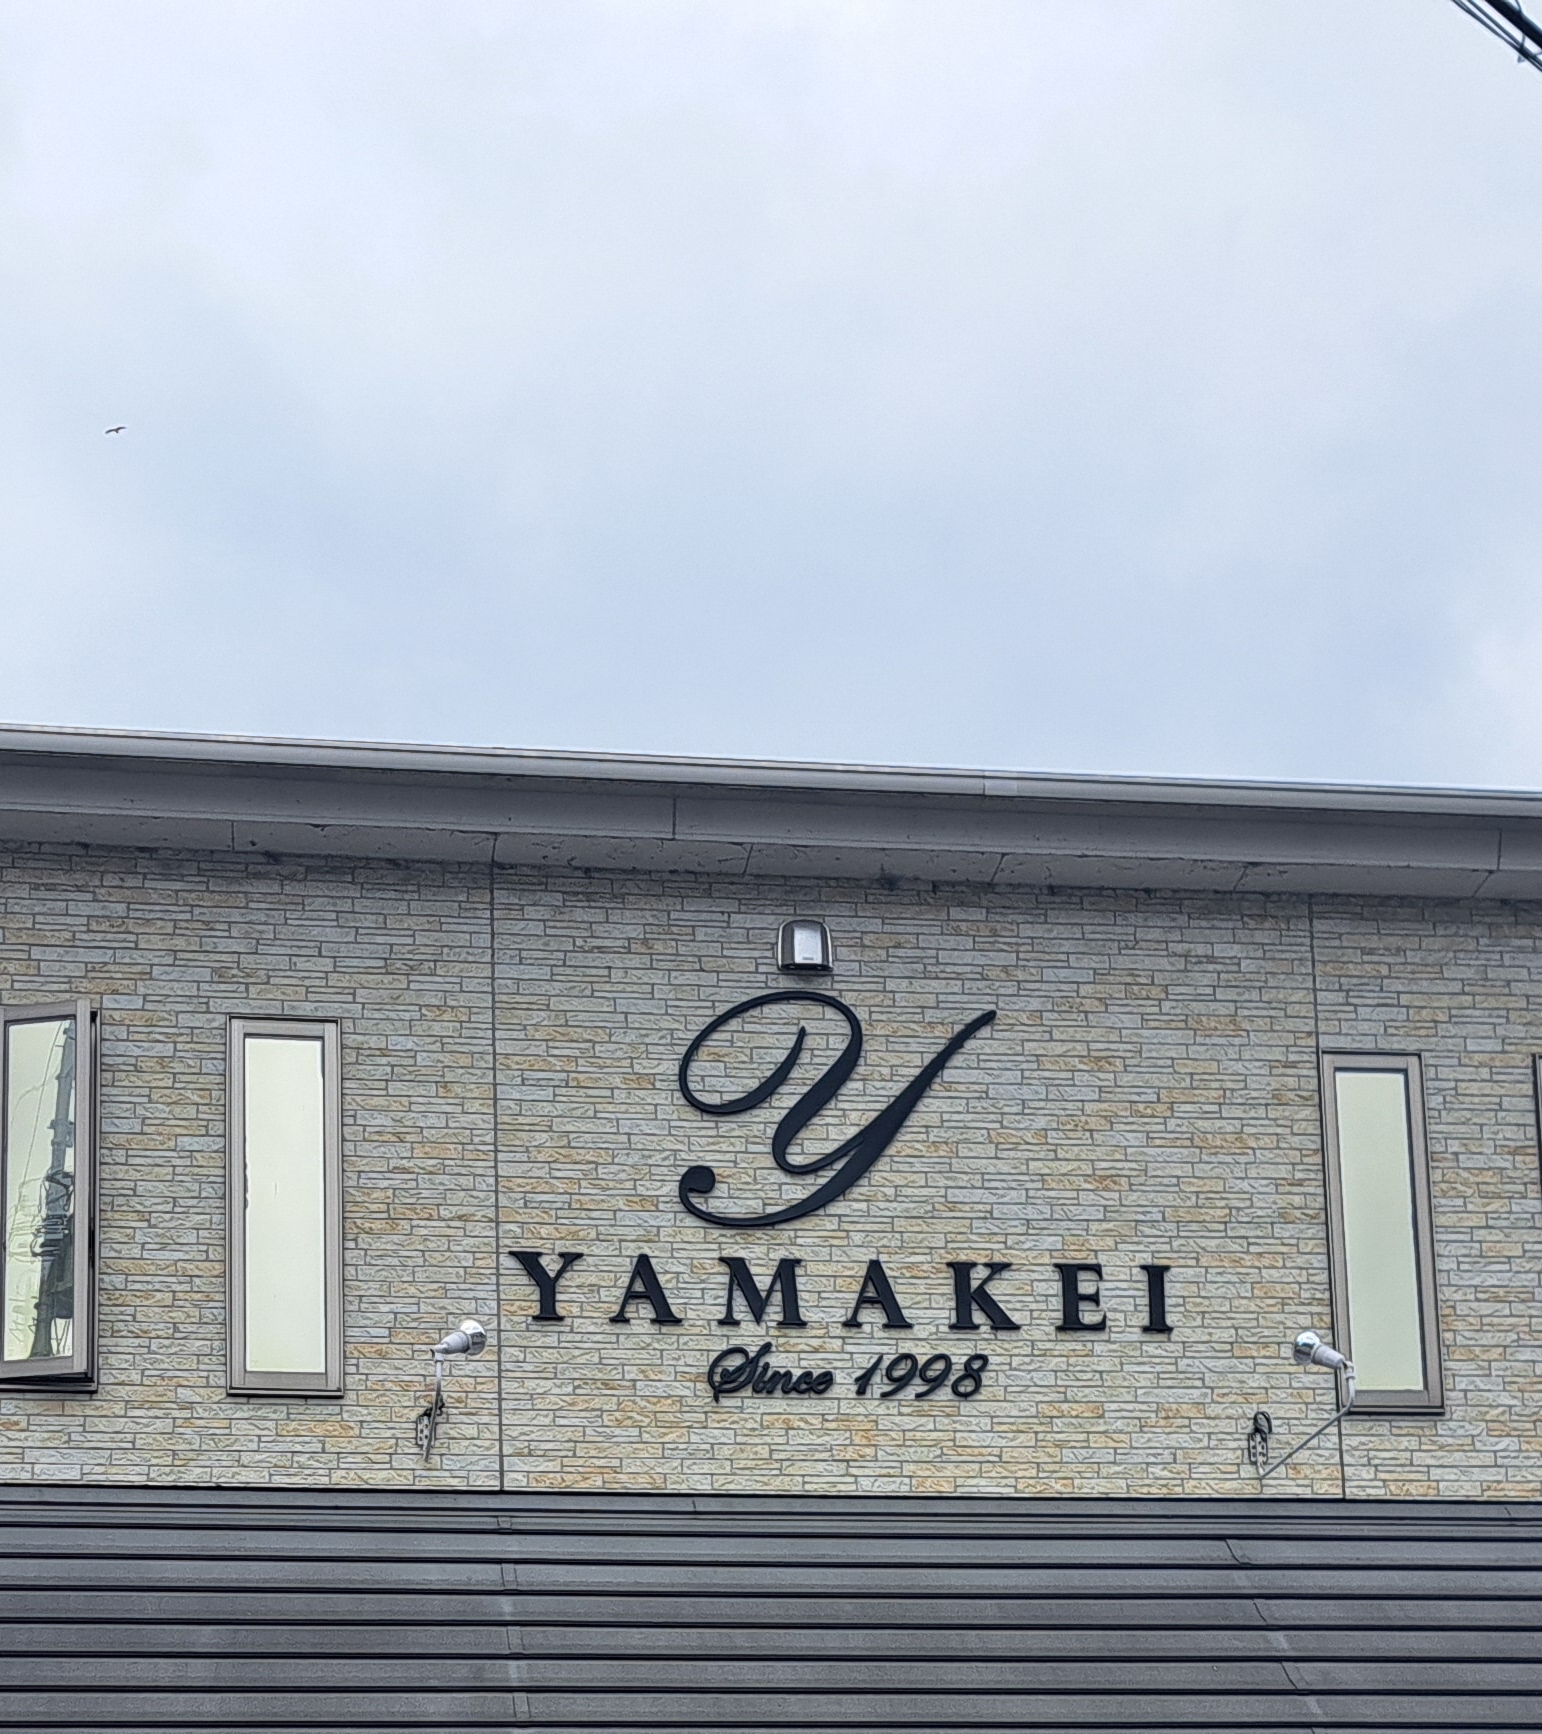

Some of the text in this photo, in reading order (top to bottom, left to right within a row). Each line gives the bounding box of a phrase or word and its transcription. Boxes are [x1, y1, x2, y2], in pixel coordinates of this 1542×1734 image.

[509, 1250, 1173, 1333] YAMAKEI
[707, 1341, 990, 1403] Since 1998
